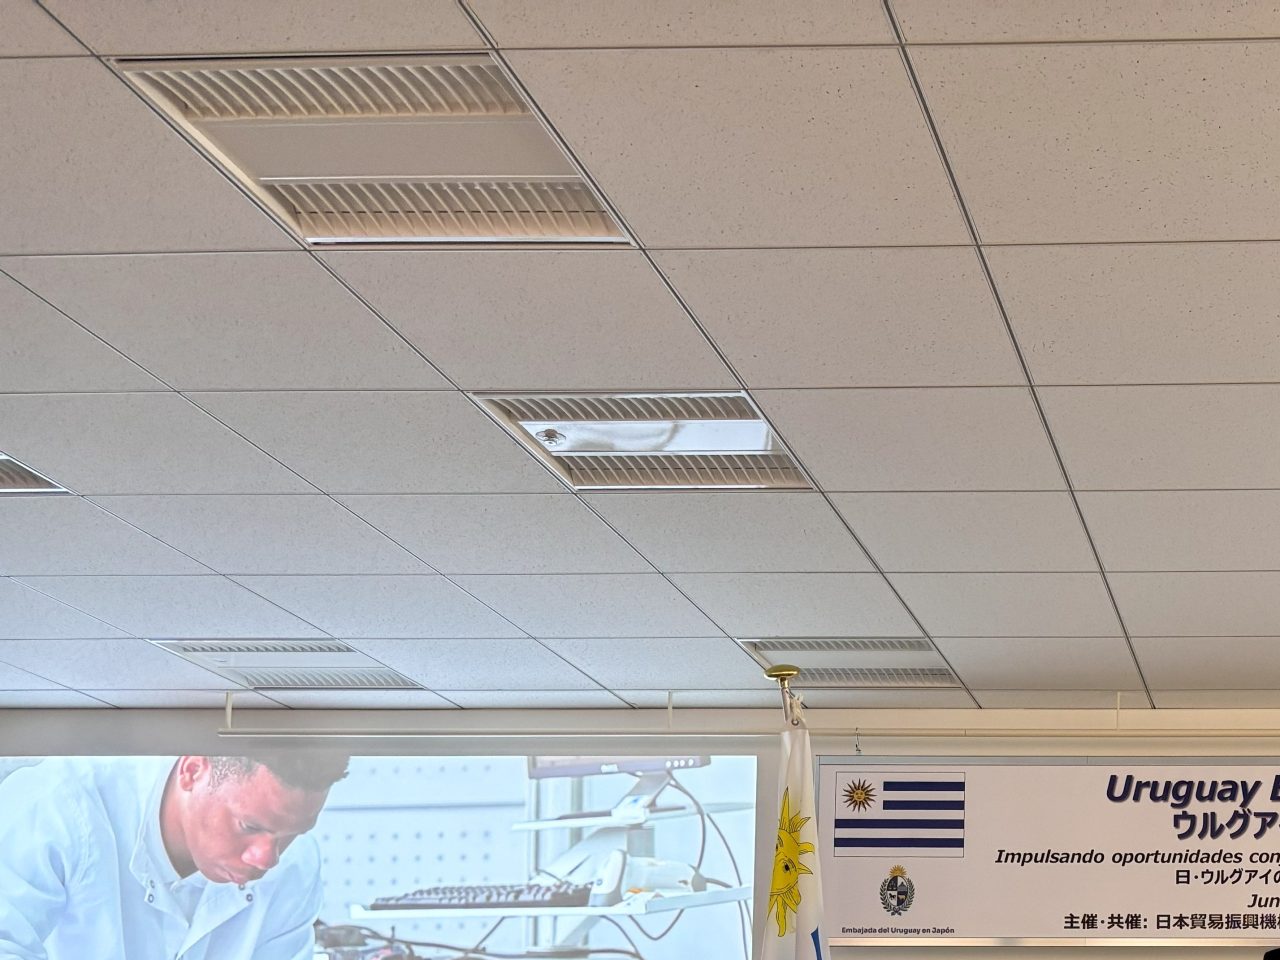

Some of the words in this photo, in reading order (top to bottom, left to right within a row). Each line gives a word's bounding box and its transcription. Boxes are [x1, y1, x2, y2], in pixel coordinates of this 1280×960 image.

[1106, 773, 1262, 808] Uruguay
[994, 849, 1105, 865] Impulsando
[1111, 849, 1244, 867] oportunidades
[841, 926, 877, 935] Embajada
[878, 926, 890, 934] del
[890, 927, 921, 935] Uruguay
[931, 926, 955, 935] Japón
